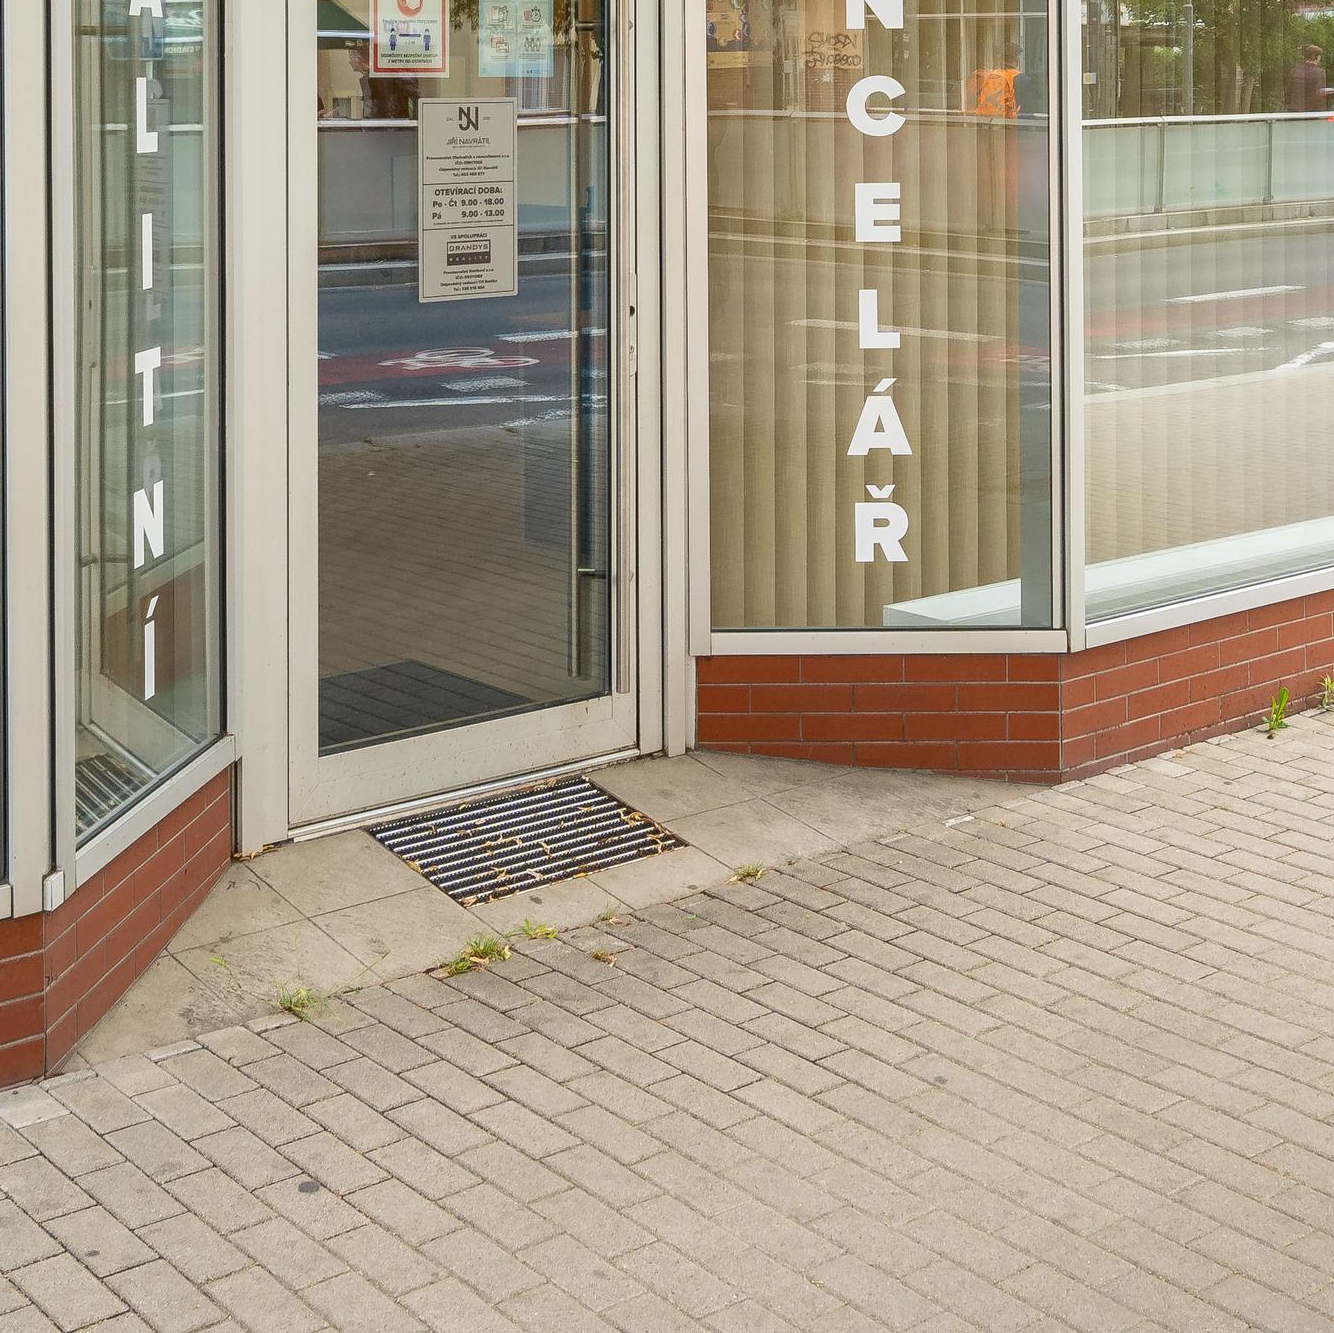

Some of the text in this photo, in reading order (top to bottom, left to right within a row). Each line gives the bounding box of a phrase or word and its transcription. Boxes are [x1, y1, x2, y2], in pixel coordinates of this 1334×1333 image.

[434, 185, 502, 196] OTEVÍRACÍ DOBA:
[433, 200, 442, 208] Po
[449, 197, 457, 207] Čt
[484, 198, 504, 206] 18.00
[432, 209, 505, 220] Pá 9.00 13.00
